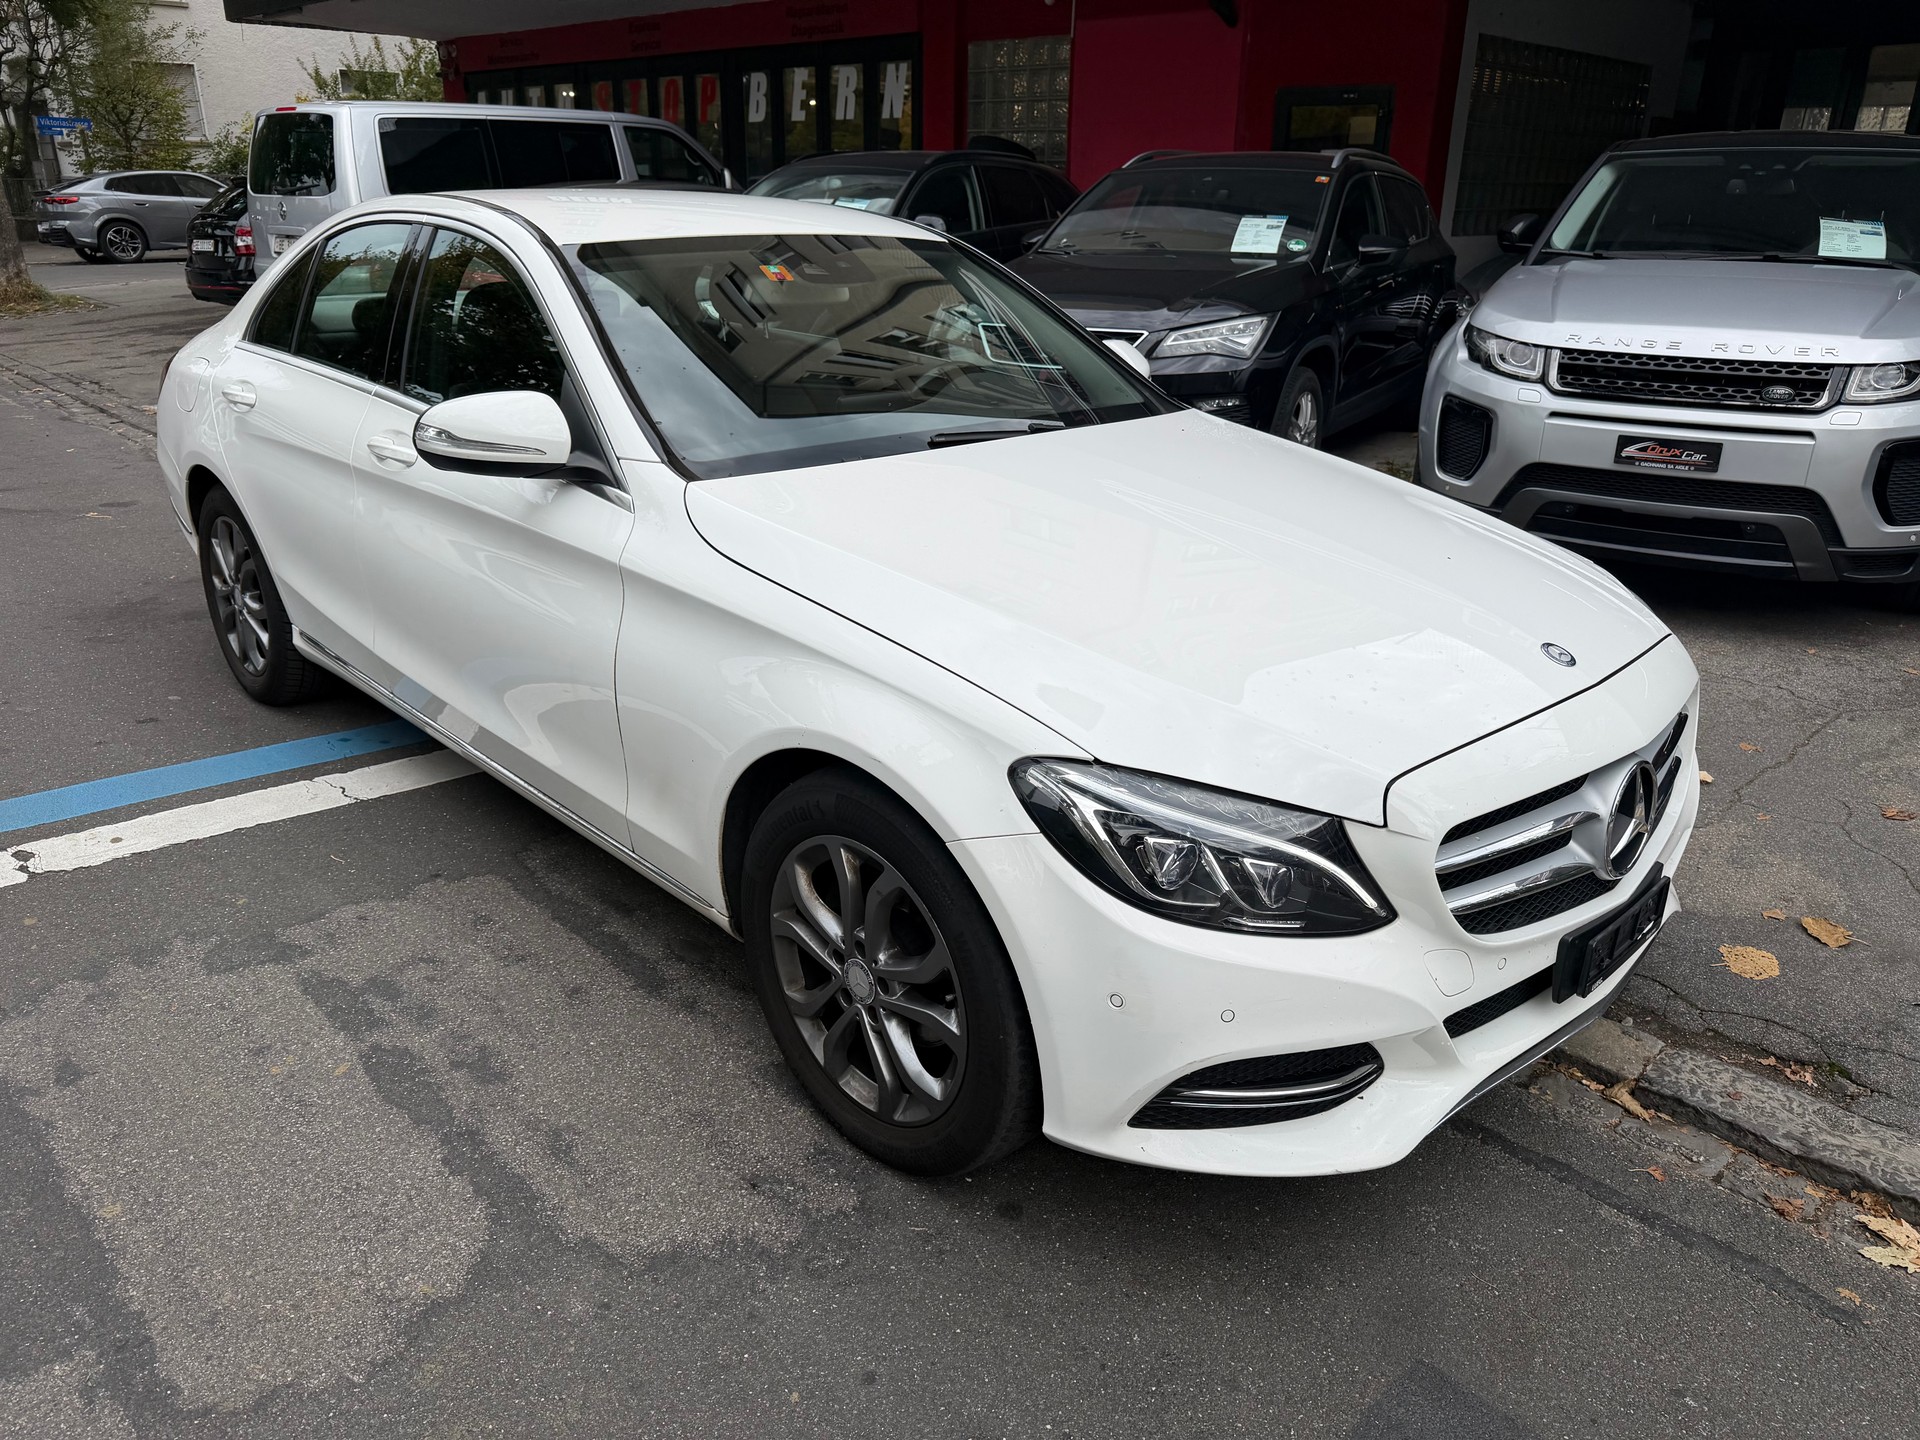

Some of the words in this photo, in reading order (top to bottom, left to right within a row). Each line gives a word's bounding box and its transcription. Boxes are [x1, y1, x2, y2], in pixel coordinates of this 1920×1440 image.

[748, 63, 907, 122] BERN
[1565, 334, 1682, 350] RANGE
[1711, 342, 1840, 357] ROVER
[1681, 451, 1707, 460] Car
